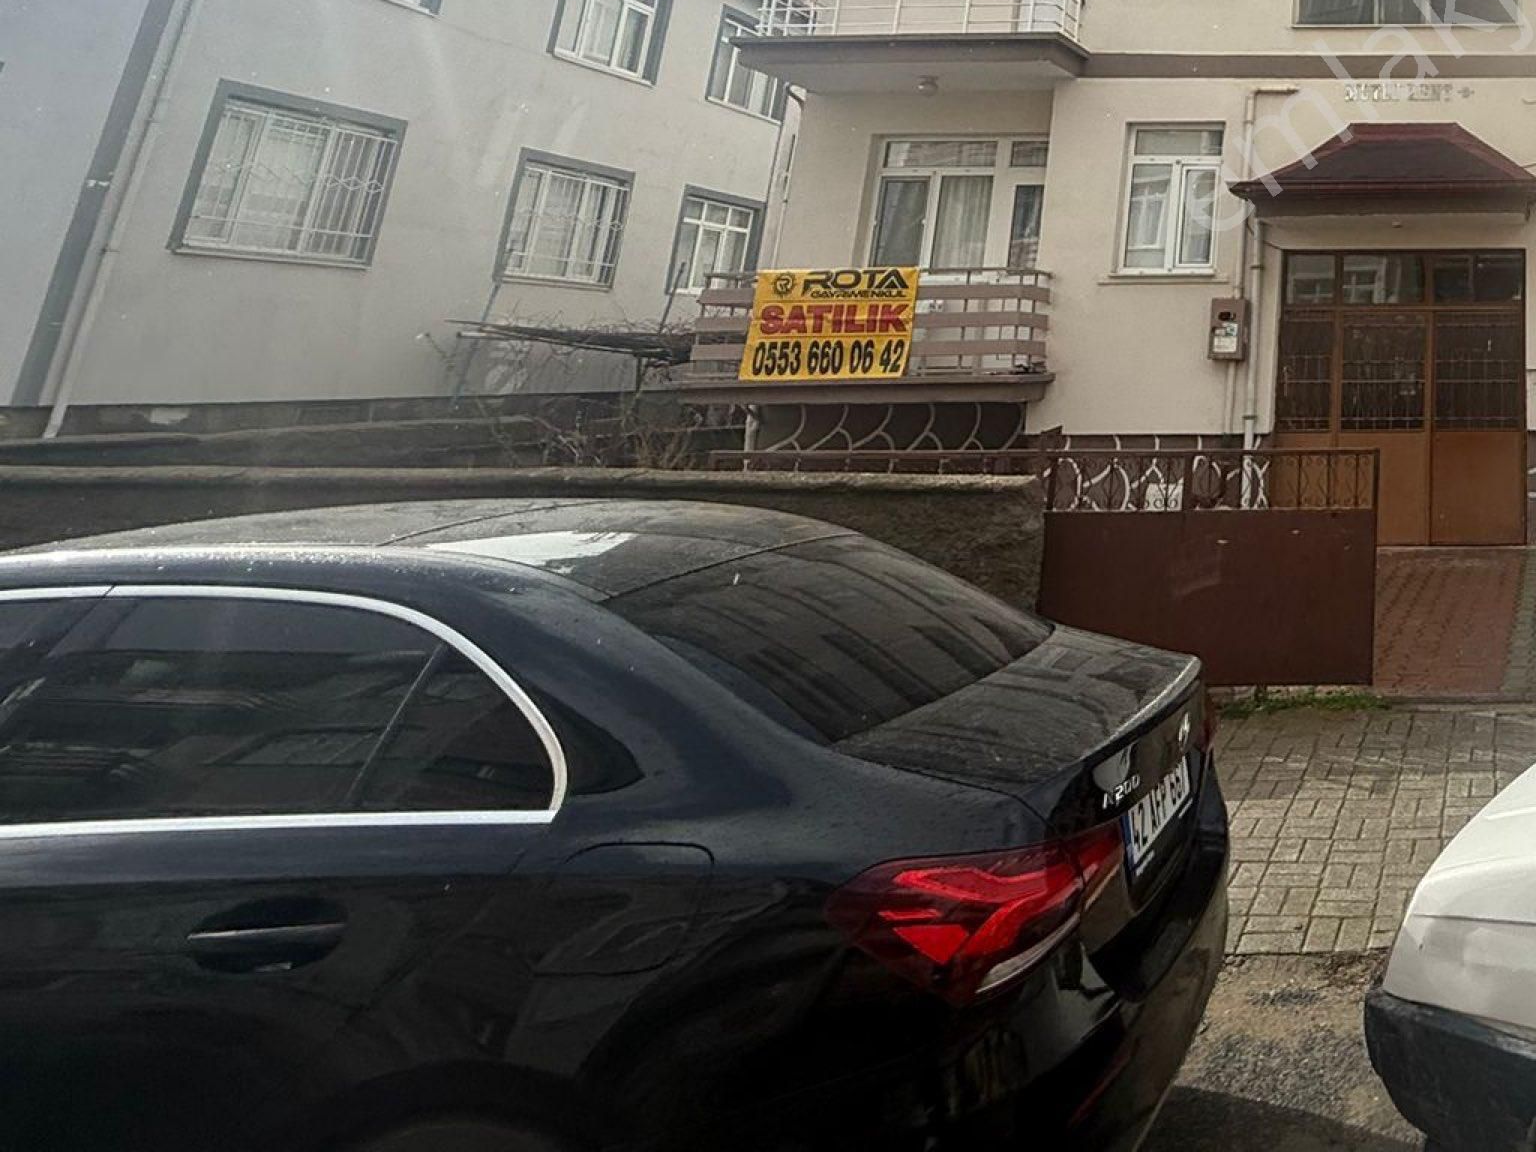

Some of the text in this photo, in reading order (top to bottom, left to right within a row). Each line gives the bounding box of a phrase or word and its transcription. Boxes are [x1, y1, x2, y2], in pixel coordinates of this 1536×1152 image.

[802, 269, 909, 297] ROTA
[761, 304, 908, 334] SATILIK
[752, 338, 905, 376] 0553 660 06 42
[1115, 774, 1141, 800] 200
